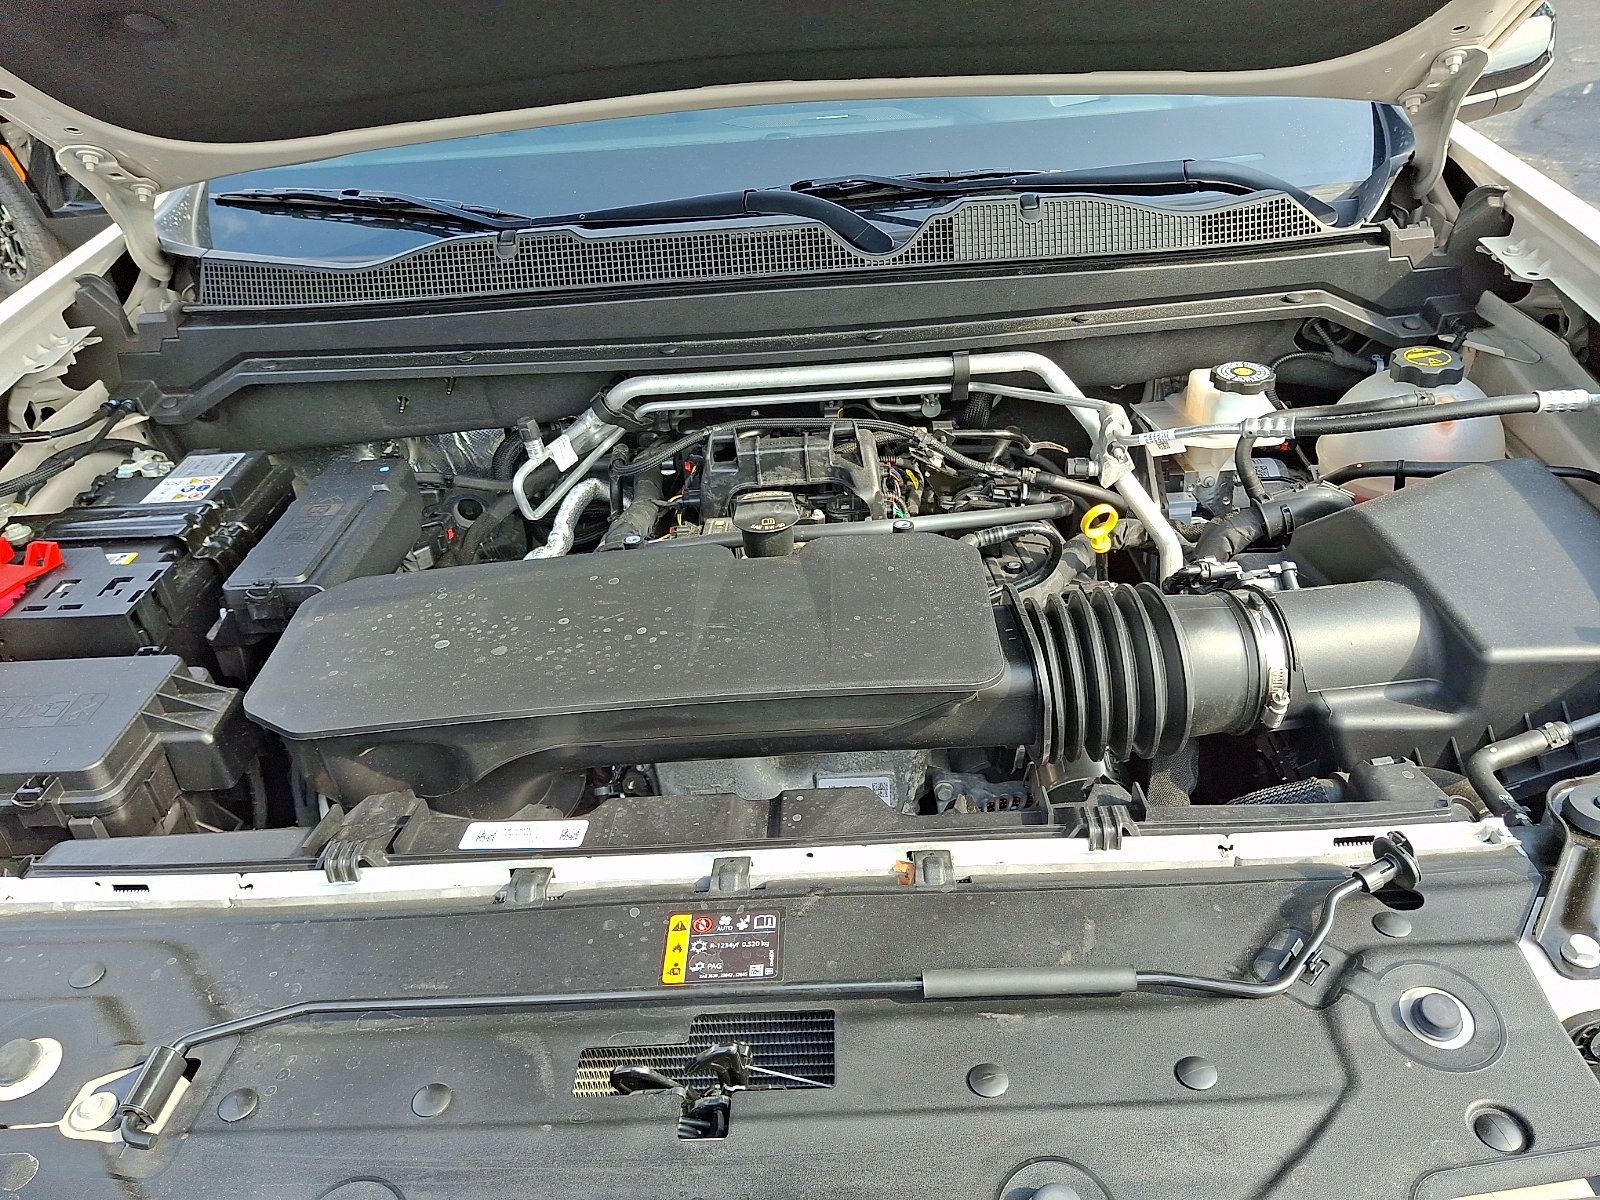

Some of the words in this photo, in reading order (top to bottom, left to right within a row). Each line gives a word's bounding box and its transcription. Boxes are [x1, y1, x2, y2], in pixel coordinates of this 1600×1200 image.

[742, 940, 760, 948] 0.520
[761, 940, 770, 948] kg
[707, 962, 722, 970] PAG
